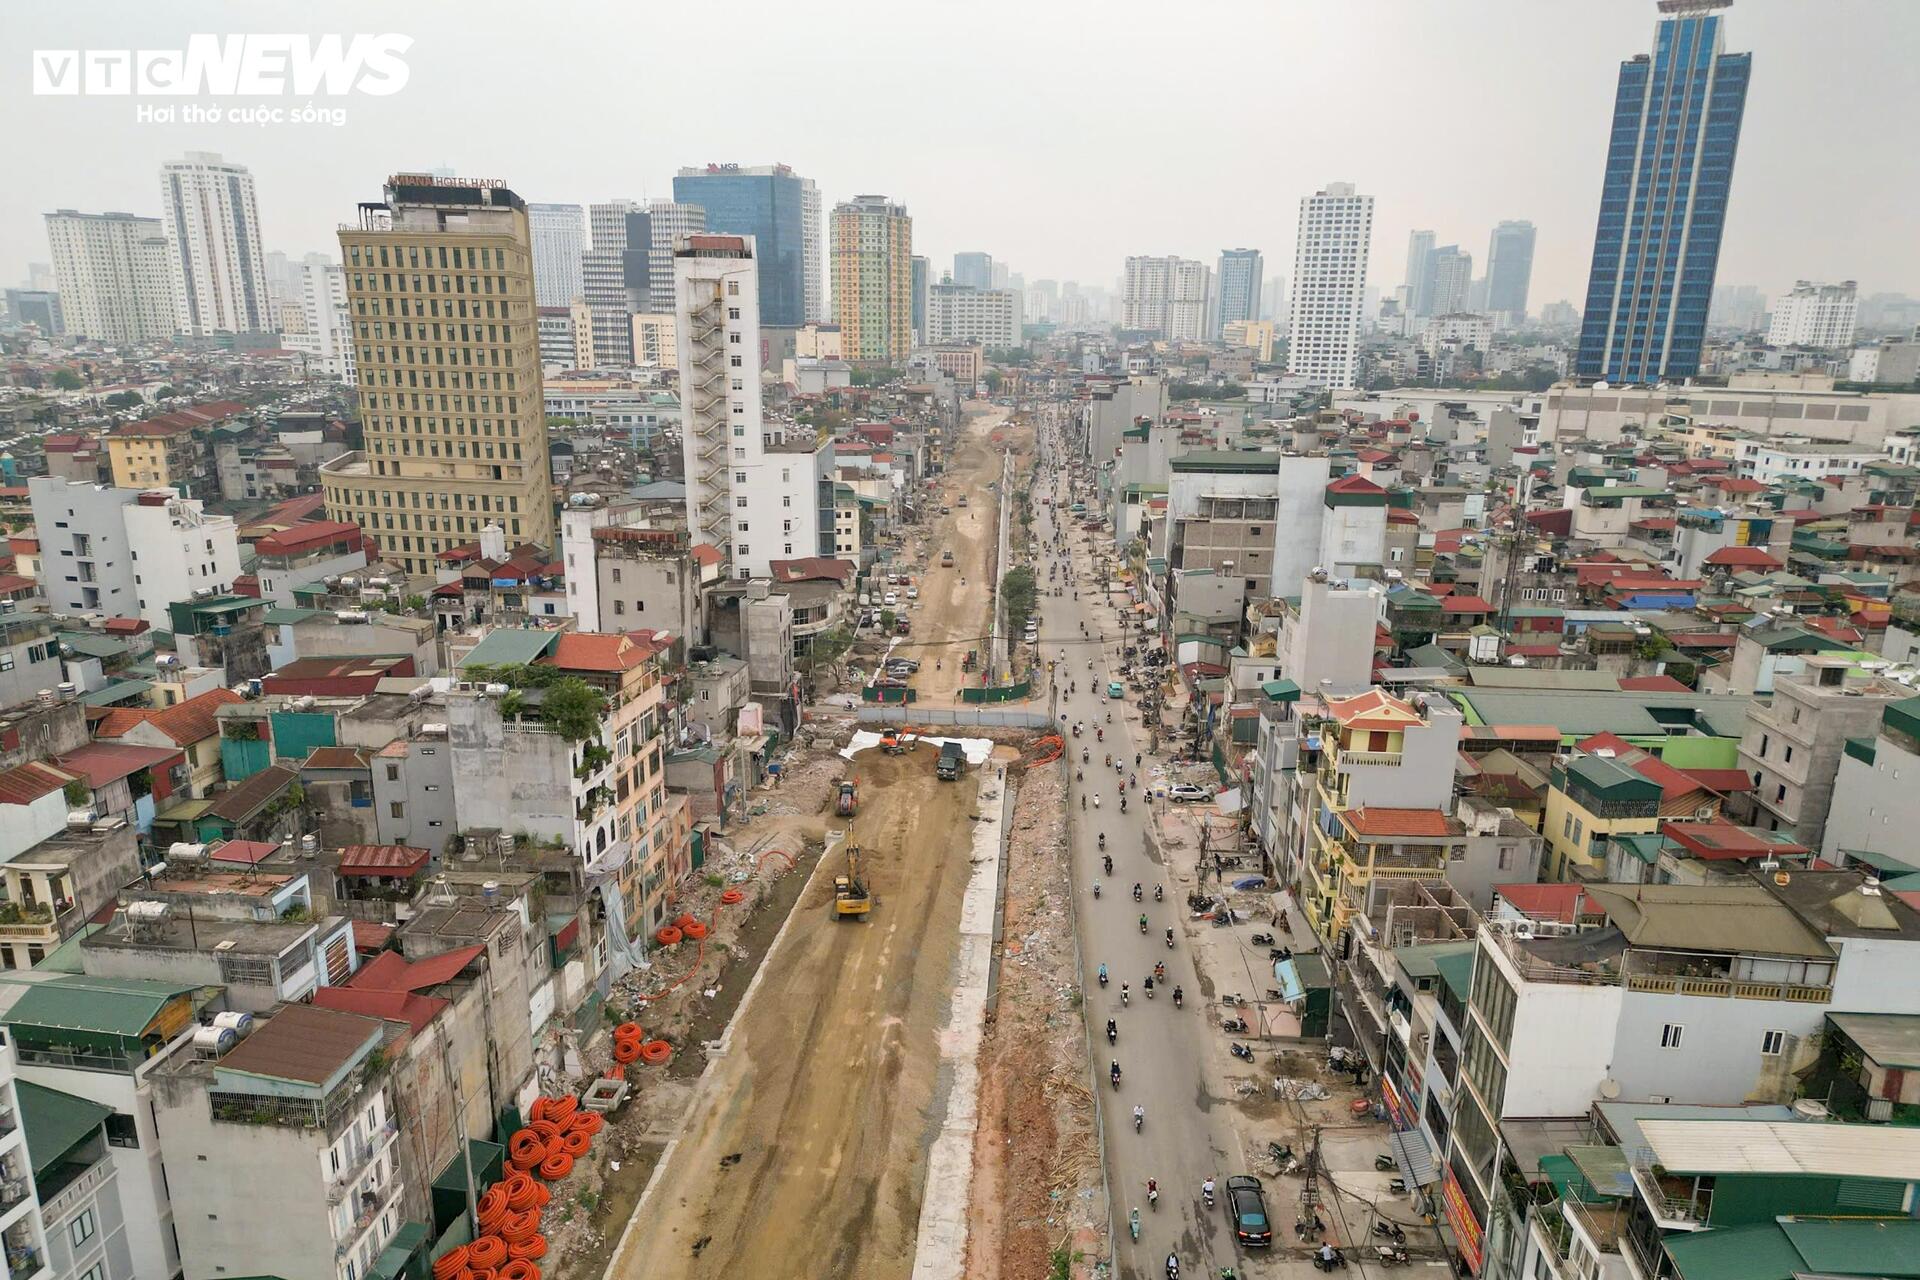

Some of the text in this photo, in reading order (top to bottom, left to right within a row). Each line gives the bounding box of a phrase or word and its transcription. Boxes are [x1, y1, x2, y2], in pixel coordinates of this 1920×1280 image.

[720, 162, 739, 171] MSB
[435, 176, 468, 189] HOTEL
[471, 178, 508, 190] HANOI
